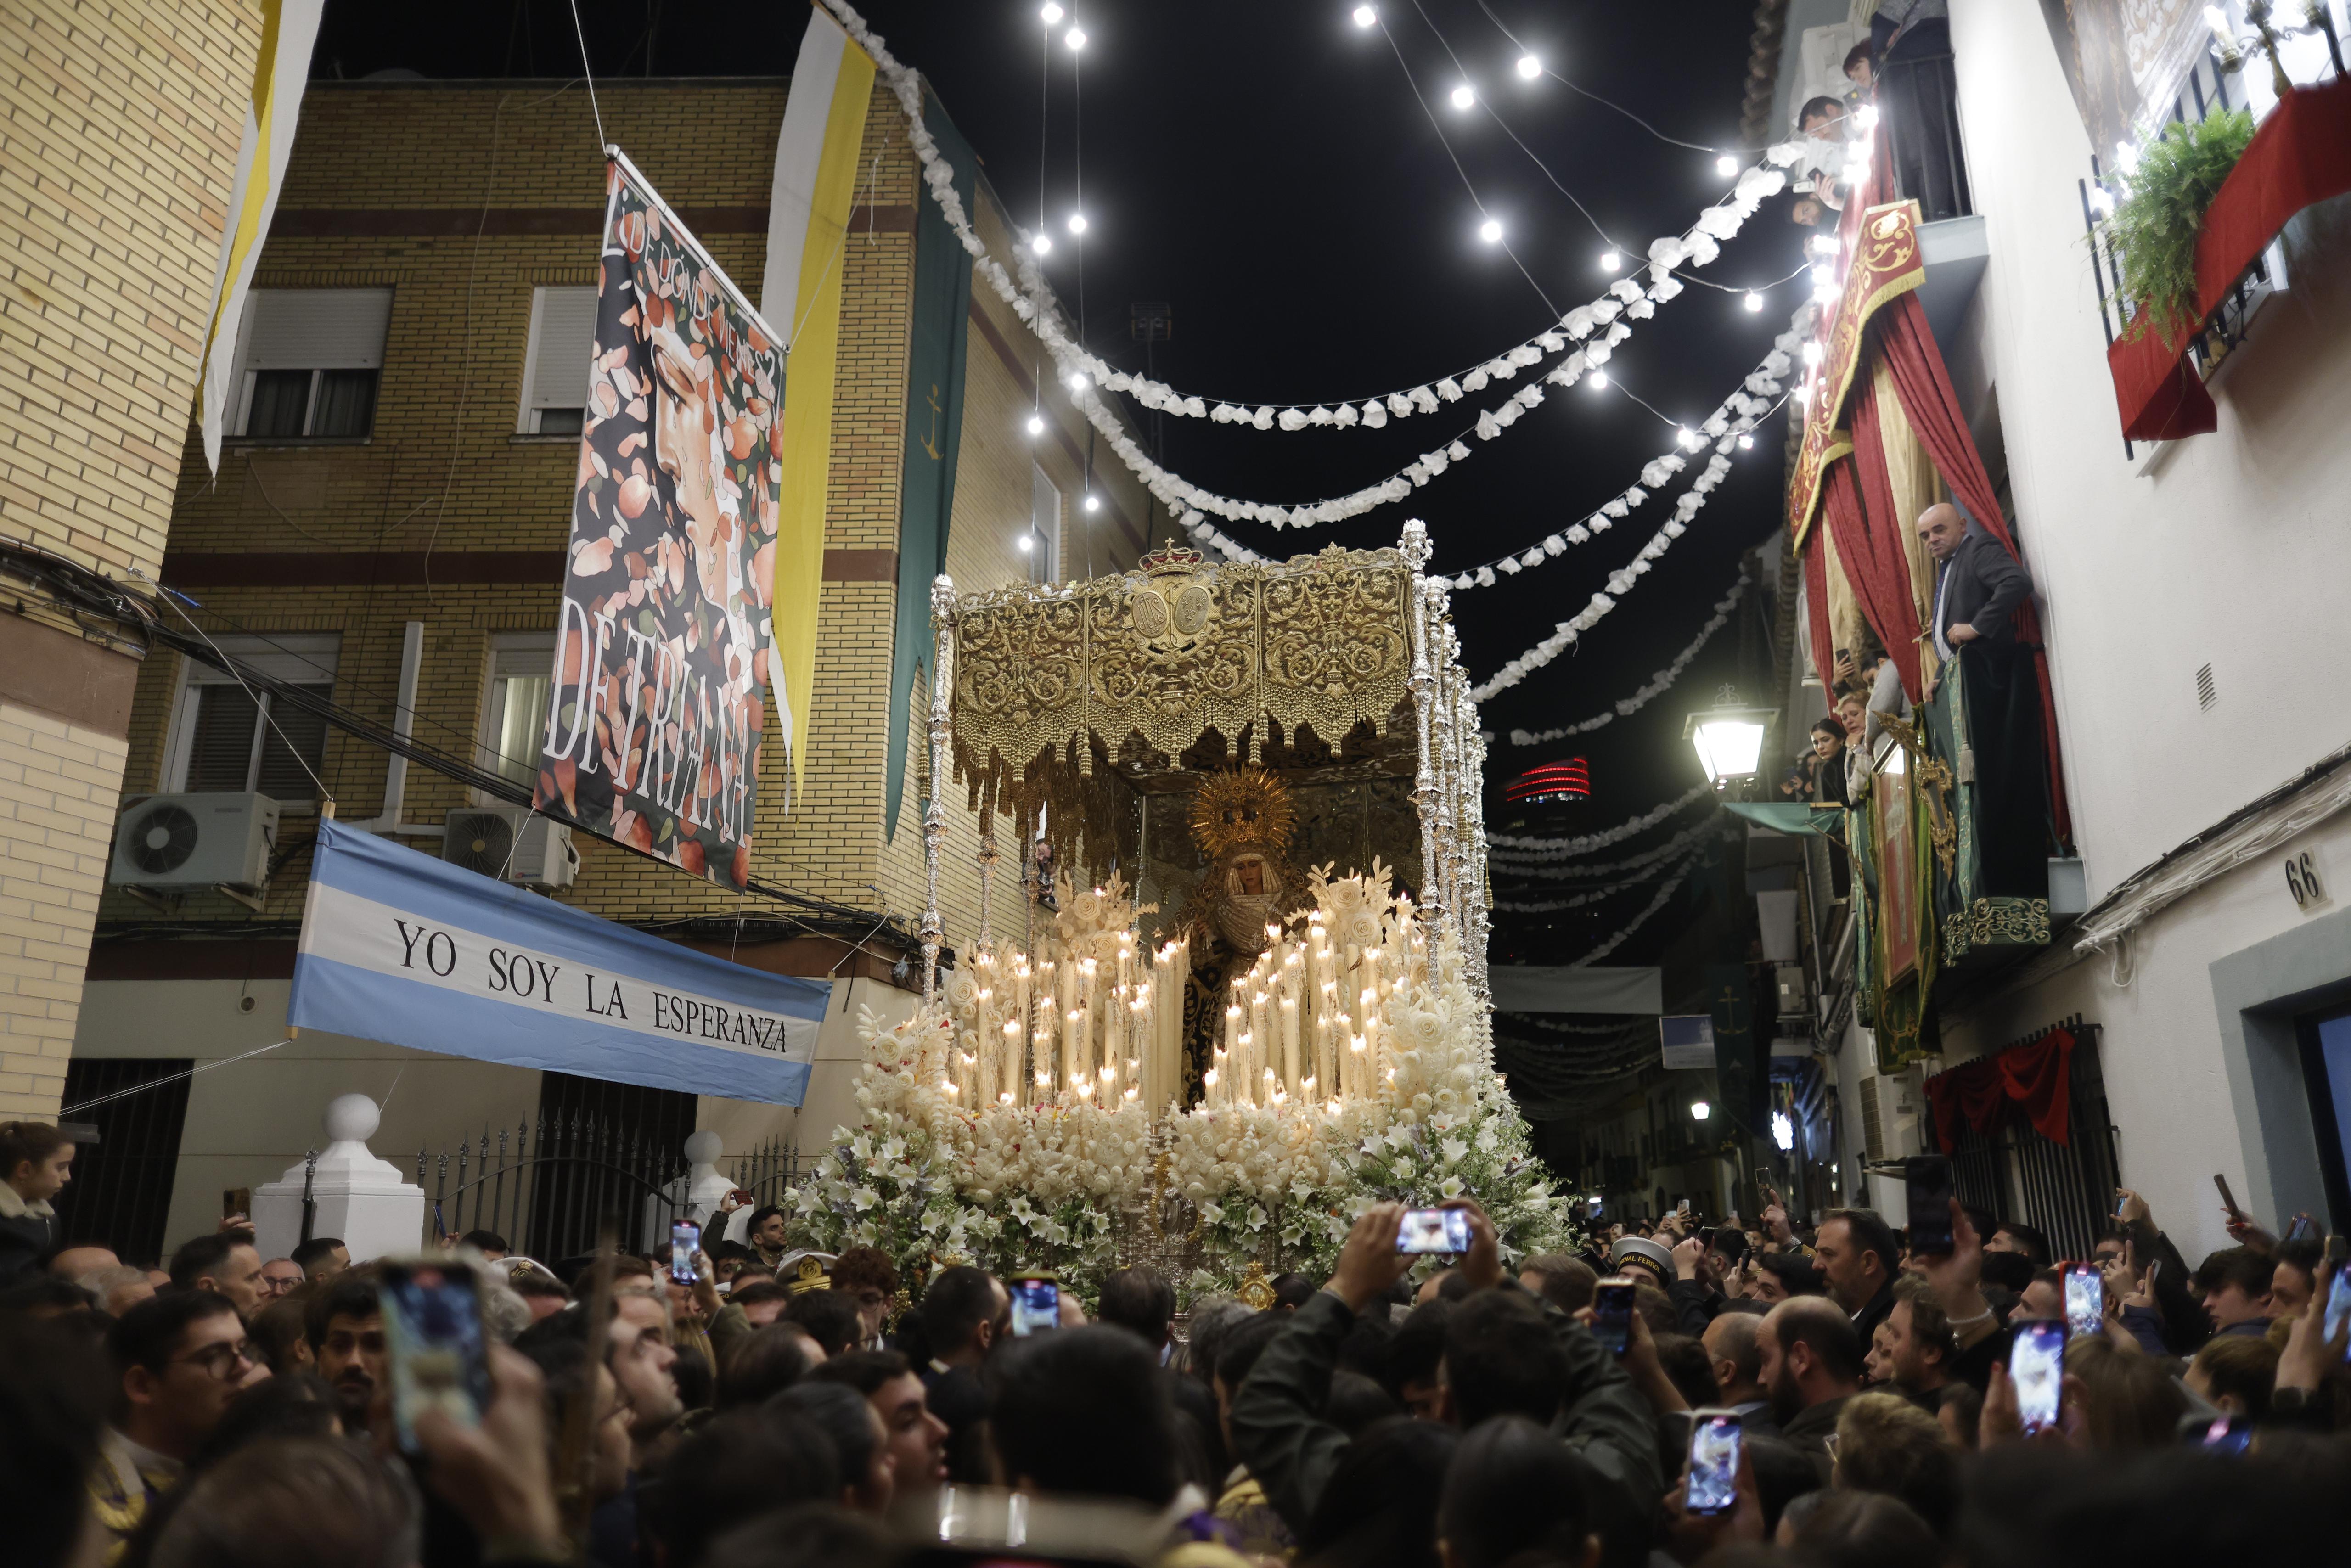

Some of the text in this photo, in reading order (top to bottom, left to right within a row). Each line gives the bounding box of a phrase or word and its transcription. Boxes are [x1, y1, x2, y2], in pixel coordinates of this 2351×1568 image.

[659, 241, 714, 334] DÓNDE
[613, 618, 748, 849] TRIANA
[2285, 853, 2318, 904] 66
[394, 918, 786, 1052] YO SOY LA ESPERANZA
[1619, 1256, 1660, 1273] RSENAL FERROL
